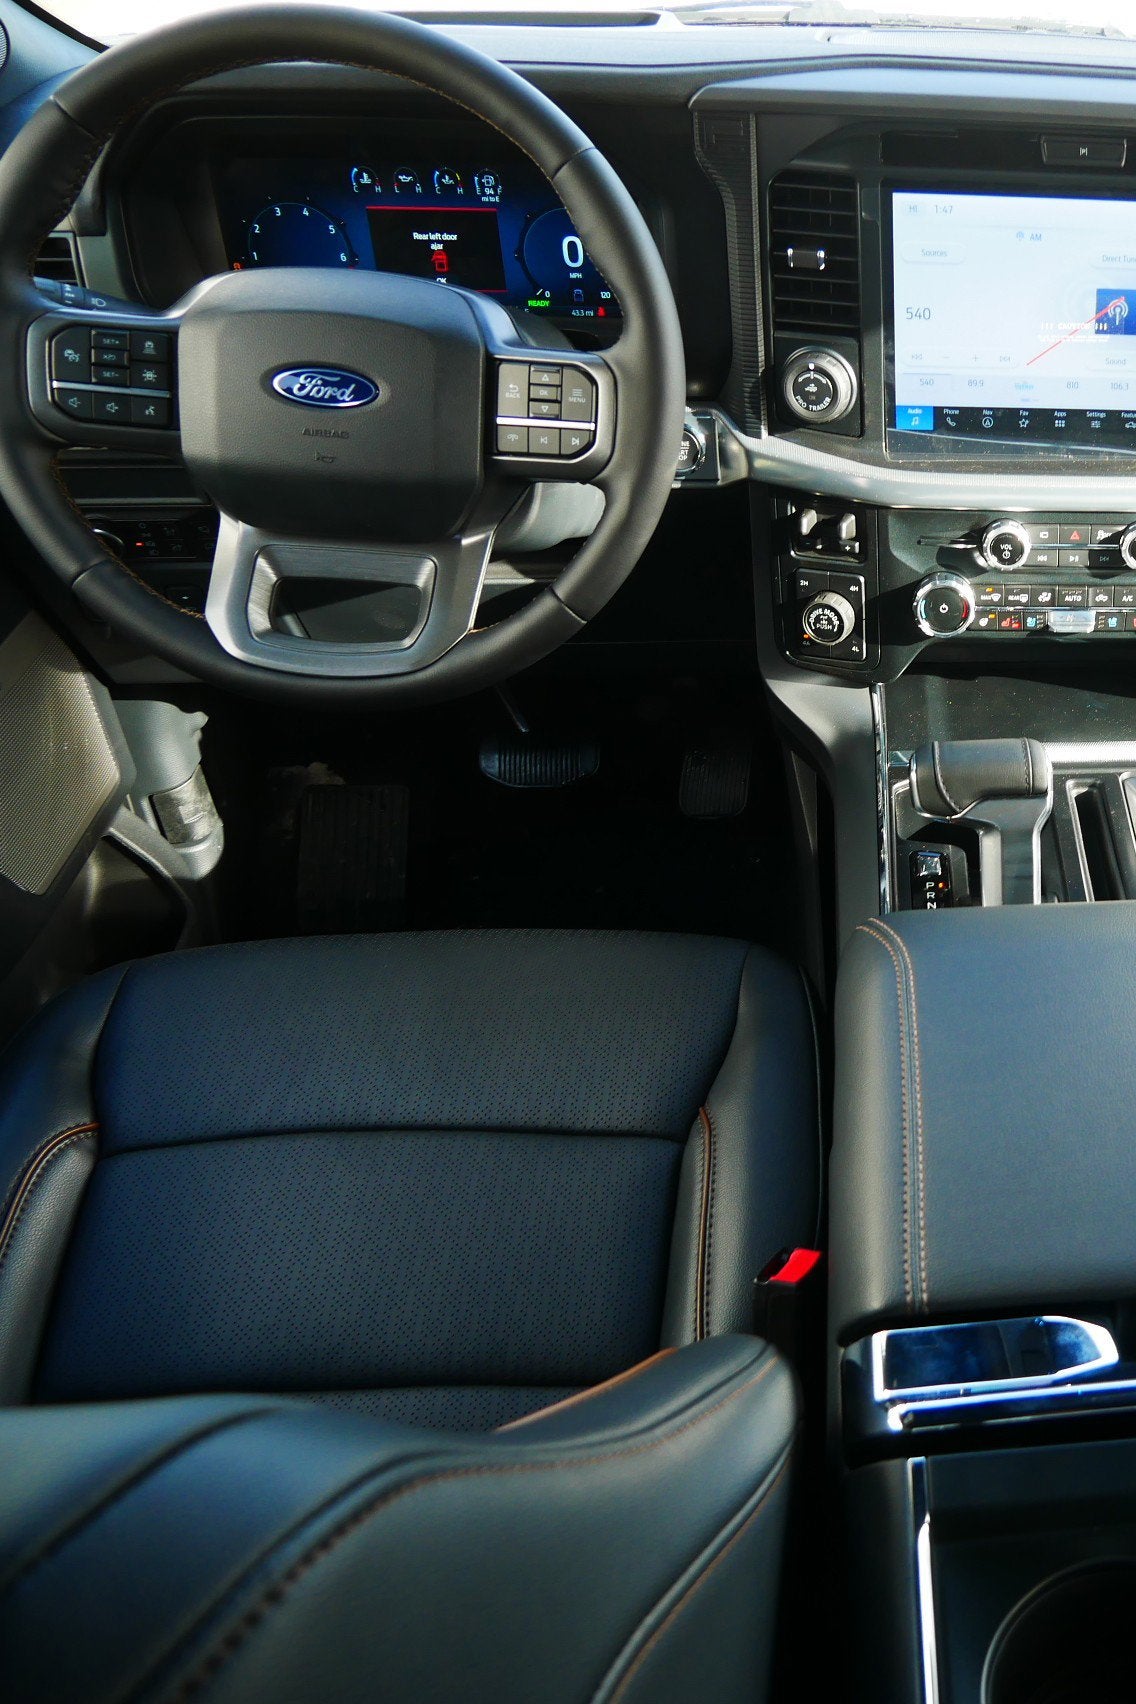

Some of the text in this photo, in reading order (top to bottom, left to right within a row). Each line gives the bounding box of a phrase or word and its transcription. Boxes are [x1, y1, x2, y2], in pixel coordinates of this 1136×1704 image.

[416, 186, 422, 194] H
[274, 207, 281, 216] 3
[302, 207, 309, 216] 4
[934, 204, 953, 214] 1:47
[254, 224, 260, 233] 2
[329, 225, 335, 234] 5
[413, 232, 428, 240] Rear
[429, 232, 441, 240] left
[1030, 233, 1042, 241] AM
[430, 242, 443, 250] ajar
[253, 252, 258, 260] 1
[562, 235, 584, 268] 0
[921, 249, 948, 257] Sources
[340, 253, 347, 262] 6
[1102, 254, 1121, 262] Direct
[906, 307, 931, 320] 540
[919, 378, 934, 386] 540
[968, 379, 984, 387] 89.9
[1066, 381, 1079, 389] 810
[293, 373, 356, 401] Ford
[796, 395, 831, 411] PRO TRAILER
[302, 428, 350, 439] AIRBAG
[809, 608, 839, 625] DRIVE MODE
[926, 882, 935, 890] P
[926, 891, 936, 899] R
[927, 901, 937, 910] N
